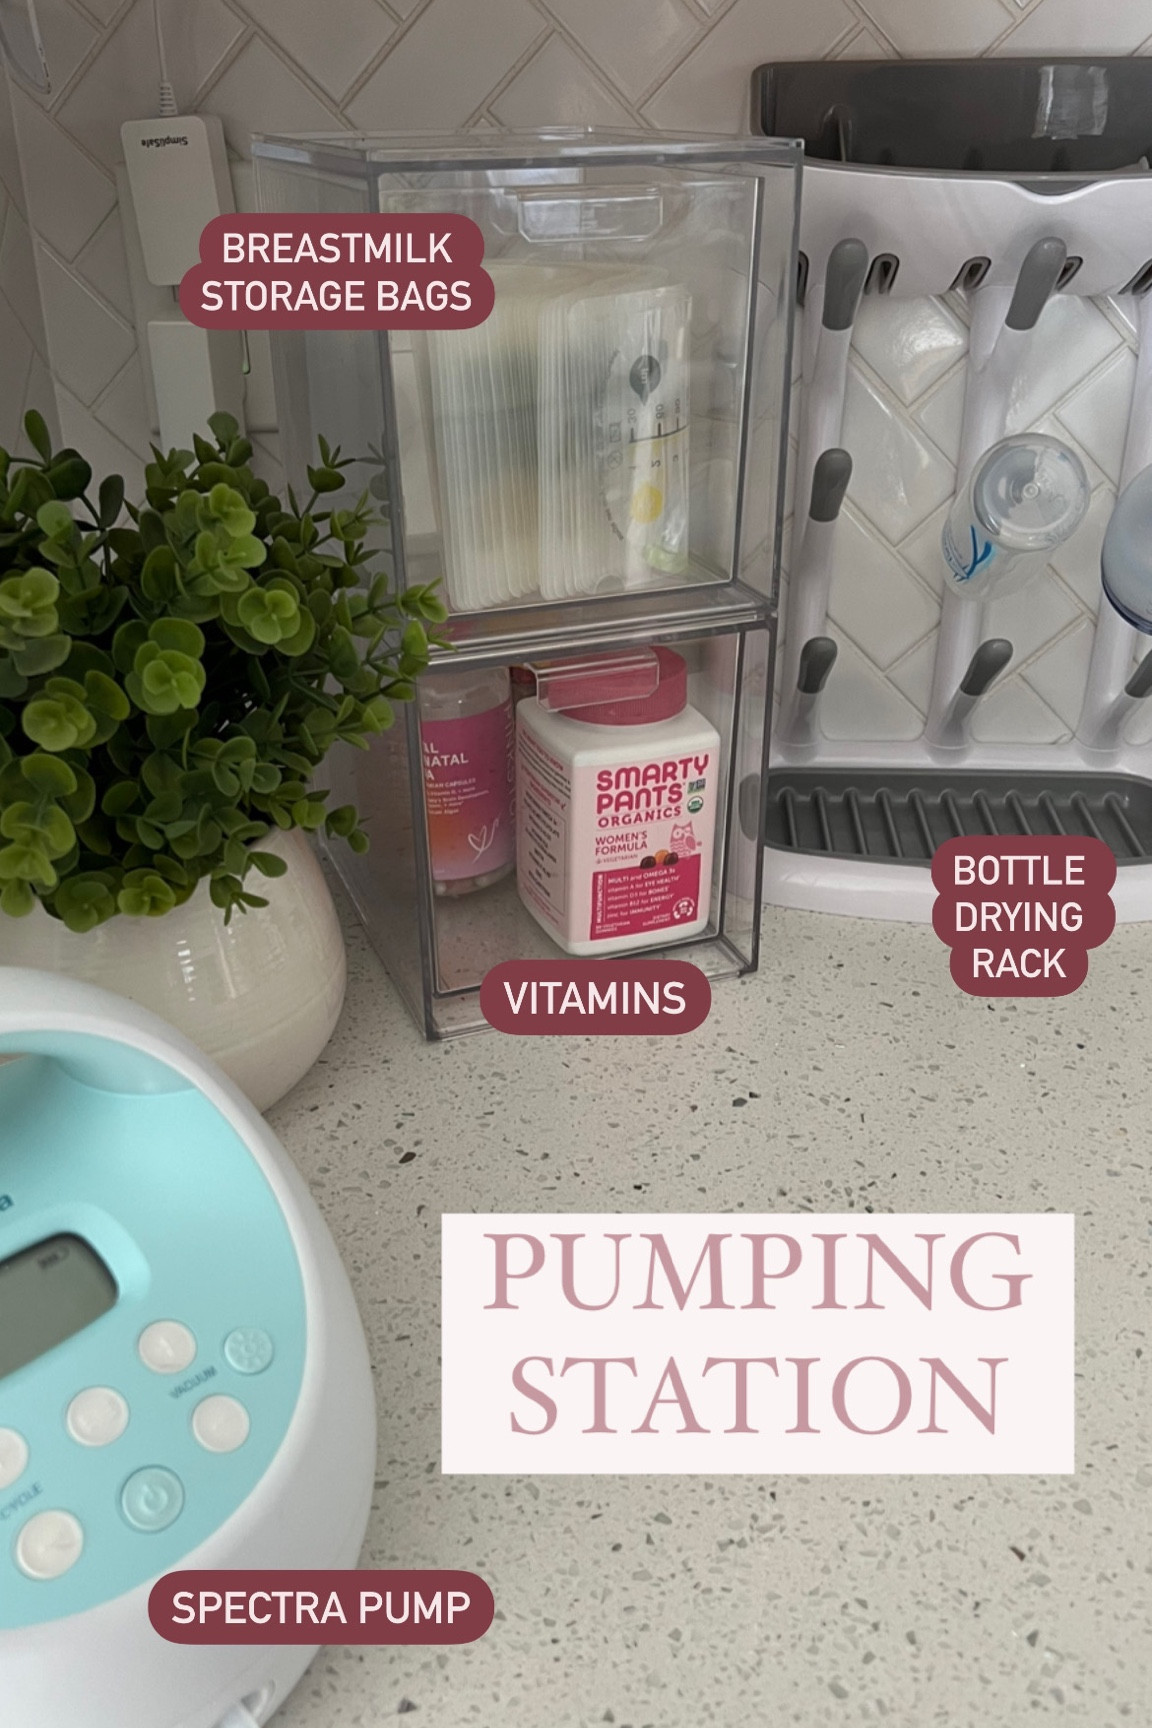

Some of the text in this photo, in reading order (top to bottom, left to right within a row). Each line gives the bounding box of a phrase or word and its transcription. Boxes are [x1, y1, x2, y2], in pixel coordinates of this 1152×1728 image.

[141, 136, 188, 148] SimpliSafe
[596, 753, 709, 791] SMARTY
[596, 782, 683, 815] PANTS
[598, 805, 681, 829] ORGANICS
[595, 830, 648, 846] WOMEN'S
[595, 841, 648, 856] FORMULA
[608, 876, 629, 885] MULTI
[643, 869, 668, 879] OMEGA
[608, 885, 628, 893] vitamin
[645, 879, 655, 887] EYE
